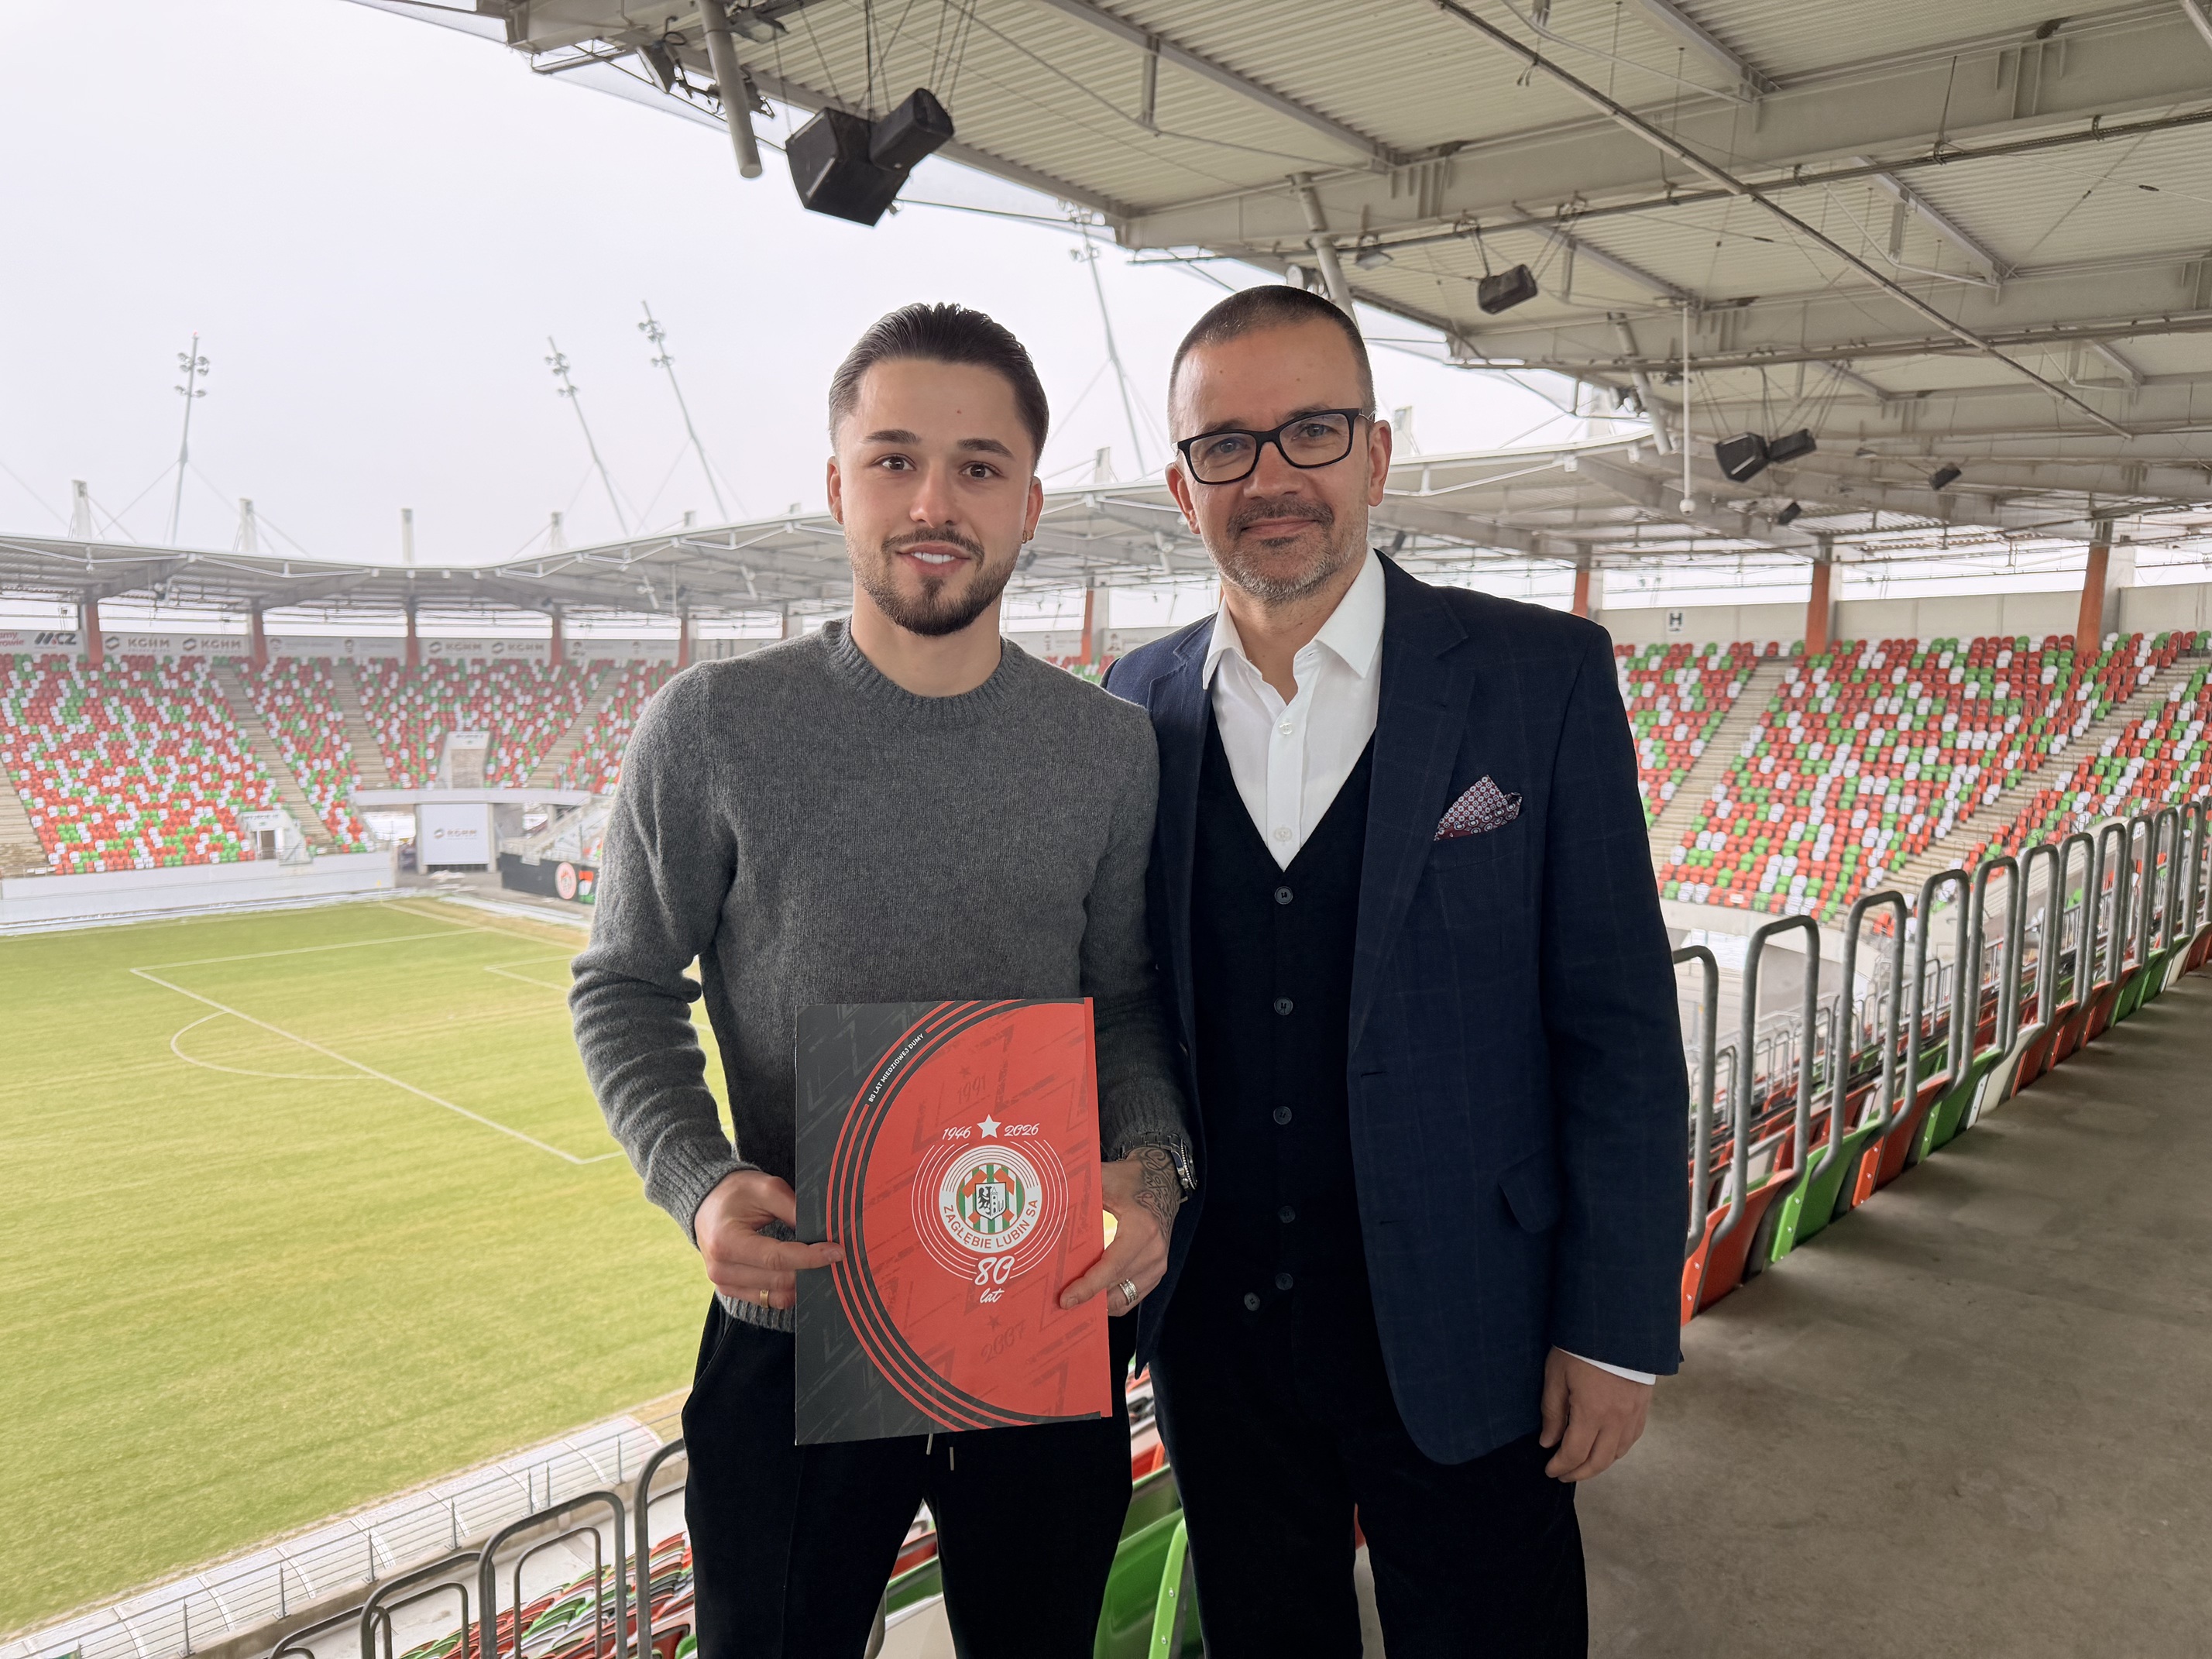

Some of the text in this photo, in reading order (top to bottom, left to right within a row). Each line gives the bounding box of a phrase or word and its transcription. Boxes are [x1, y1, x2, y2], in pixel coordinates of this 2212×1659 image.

[1669, 613, 1683, 627] H
[128, 637, 170, 647] KGHM
[201, 639, 242, 649] KGHM
[868, 1033, 924, 1103] 80 LAT MIEDZIOWEJ DUMY
[942, 1123, 1040, 1141] 1946 2026
[943, 1200, 1039, 1249] ZAGŁĘBIE LUBIN SA
[974, 1255, 1015, 1286] 80
[979, 1287, 1005, 1304] lat
